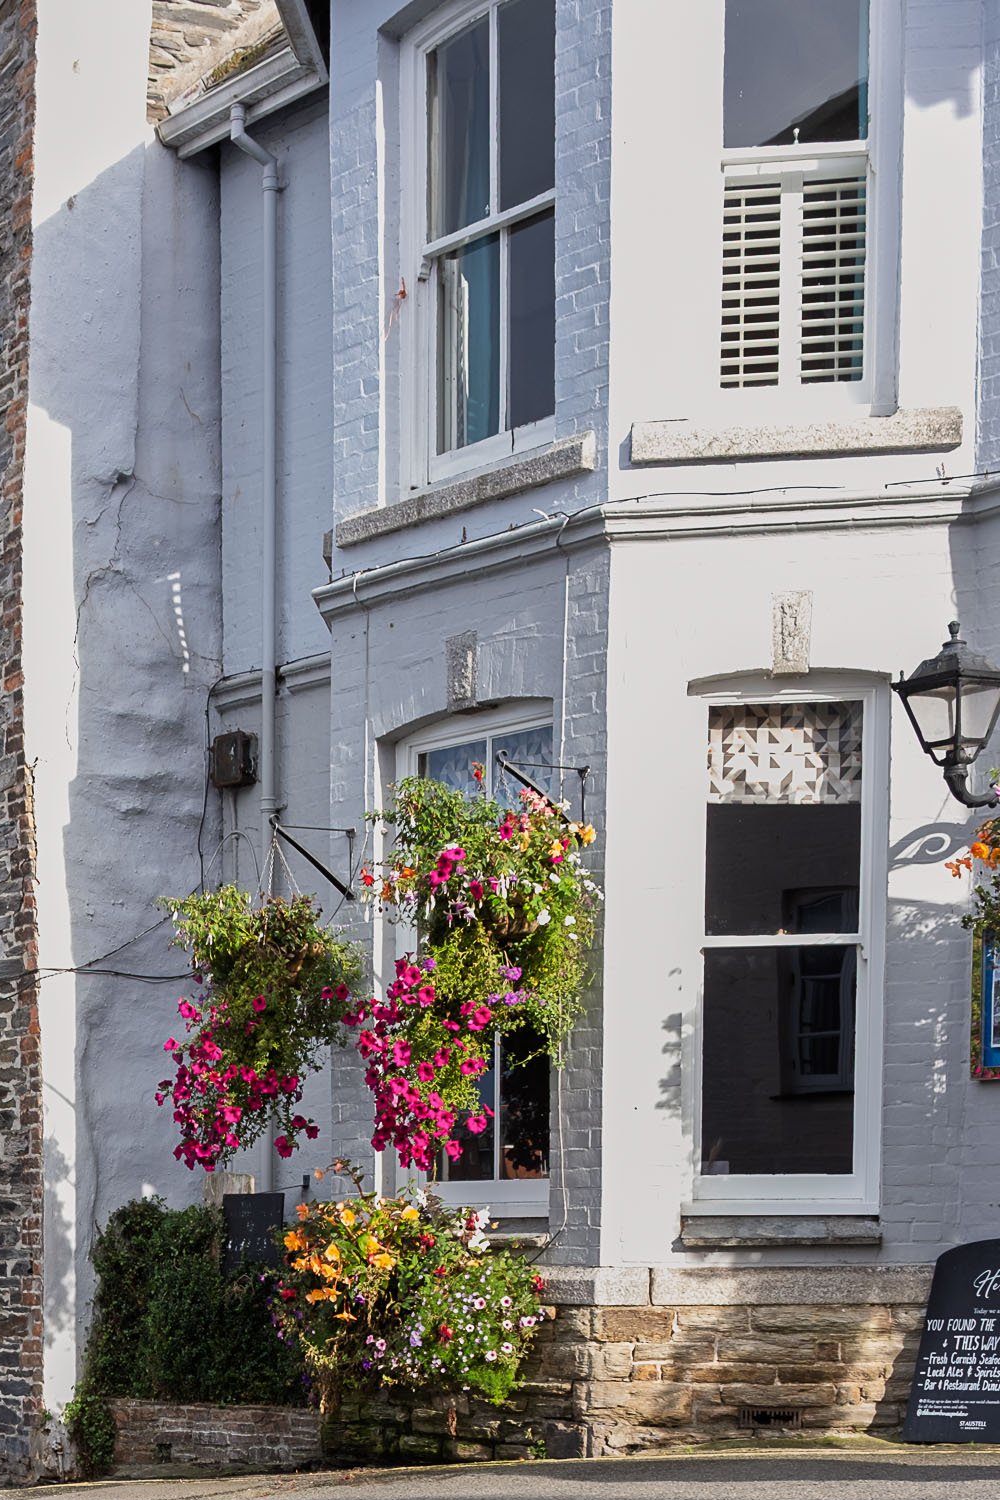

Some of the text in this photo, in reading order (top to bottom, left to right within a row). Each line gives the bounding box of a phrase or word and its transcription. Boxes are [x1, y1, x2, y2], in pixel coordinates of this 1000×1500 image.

[927, 1318, 997, 1331] YOU FOUND THE
[954, 1335, 980, 1350] THIS
[951, 1352, 977, 1364] Cornish
[978, 1353, 1000, 1365] Seafoo
[946, 1366, 964, 1377] Ales
[943, 1379, 980, 1390] Restaurant
